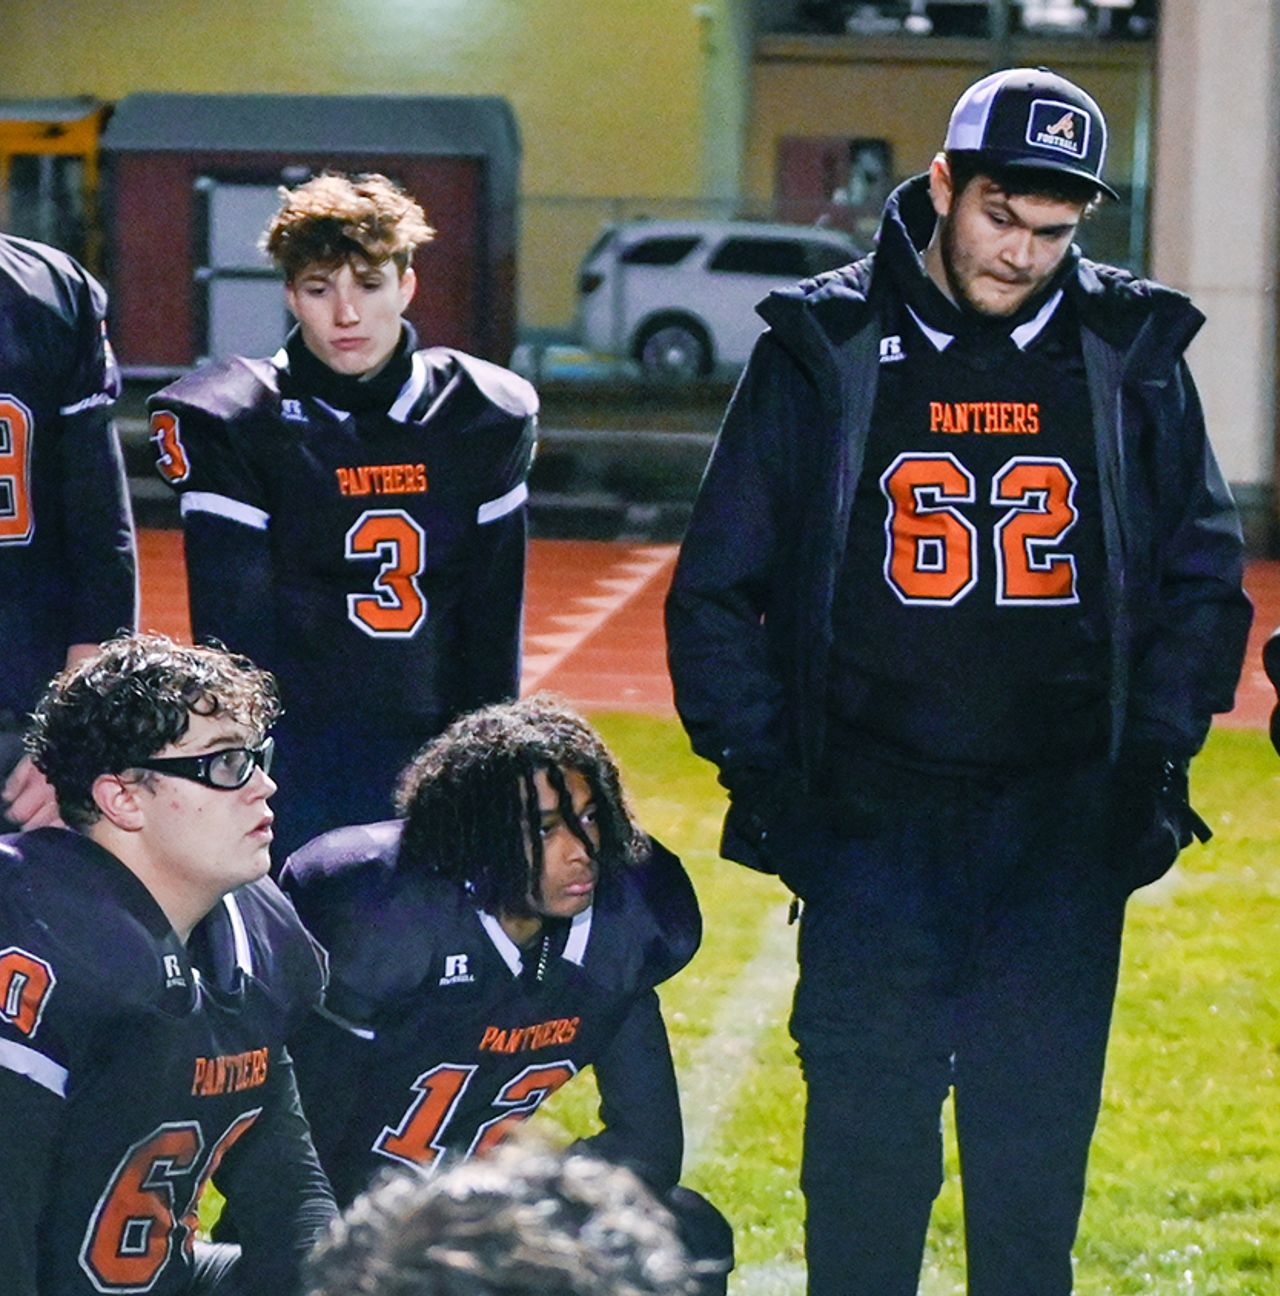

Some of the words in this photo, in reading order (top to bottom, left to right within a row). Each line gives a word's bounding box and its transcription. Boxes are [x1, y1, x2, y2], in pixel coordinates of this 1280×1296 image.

[150, 410, 191, 484] 3
[930, 401, 1041, 434] PANTHERS
[336, 463, 429, 496] PANTHERS
[879, 451, 1080, 606] 62
[345, 509, 427, 638] 3
[192, 1046, 269, 1096] PANTHERS
[479, 1016, 581, 1054] PANTHERS
[371, 1059, 579, 1179] 12
[78, 1106, 263, 1294] 6
